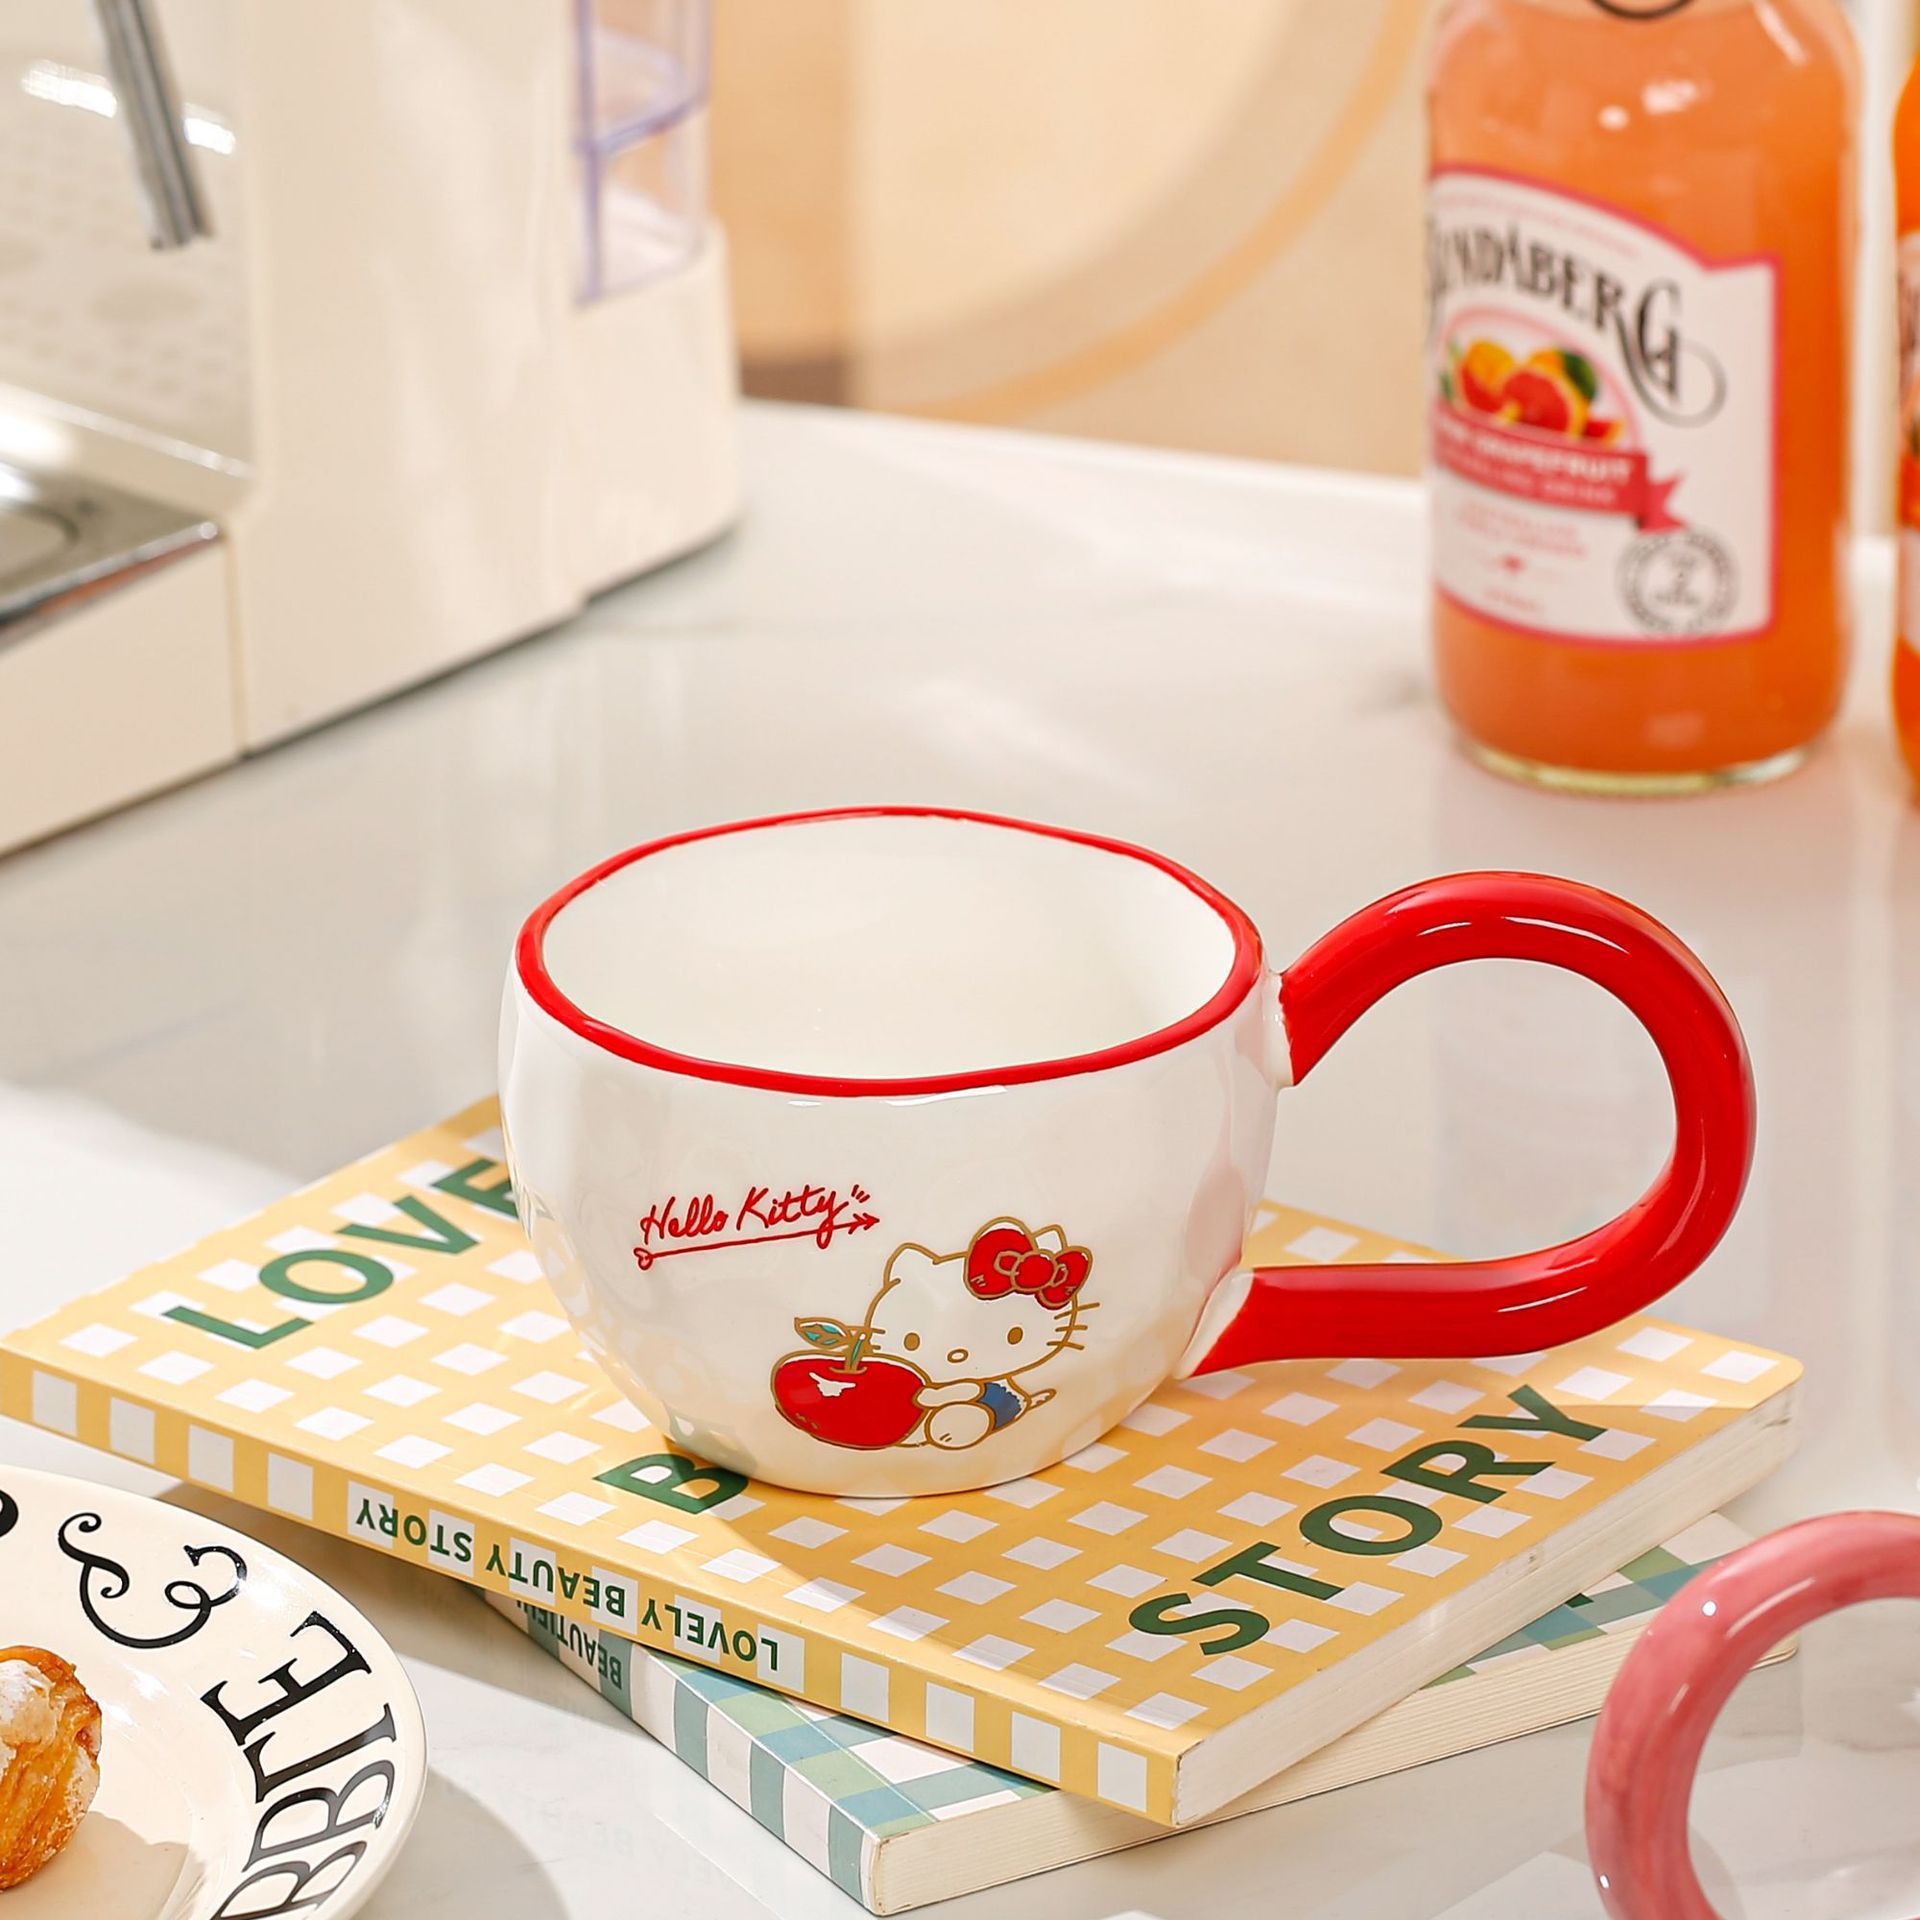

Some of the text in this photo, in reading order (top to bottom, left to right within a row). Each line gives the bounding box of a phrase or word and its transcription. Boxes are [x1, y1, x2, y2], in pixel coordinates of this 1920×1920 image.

[640, 1185, 848, 1249] Hello Kitty
[356, 1498, 779, 1671] LOVELY BEAUTY STORY
[1128, 1384, 1608, 1656] STORY
